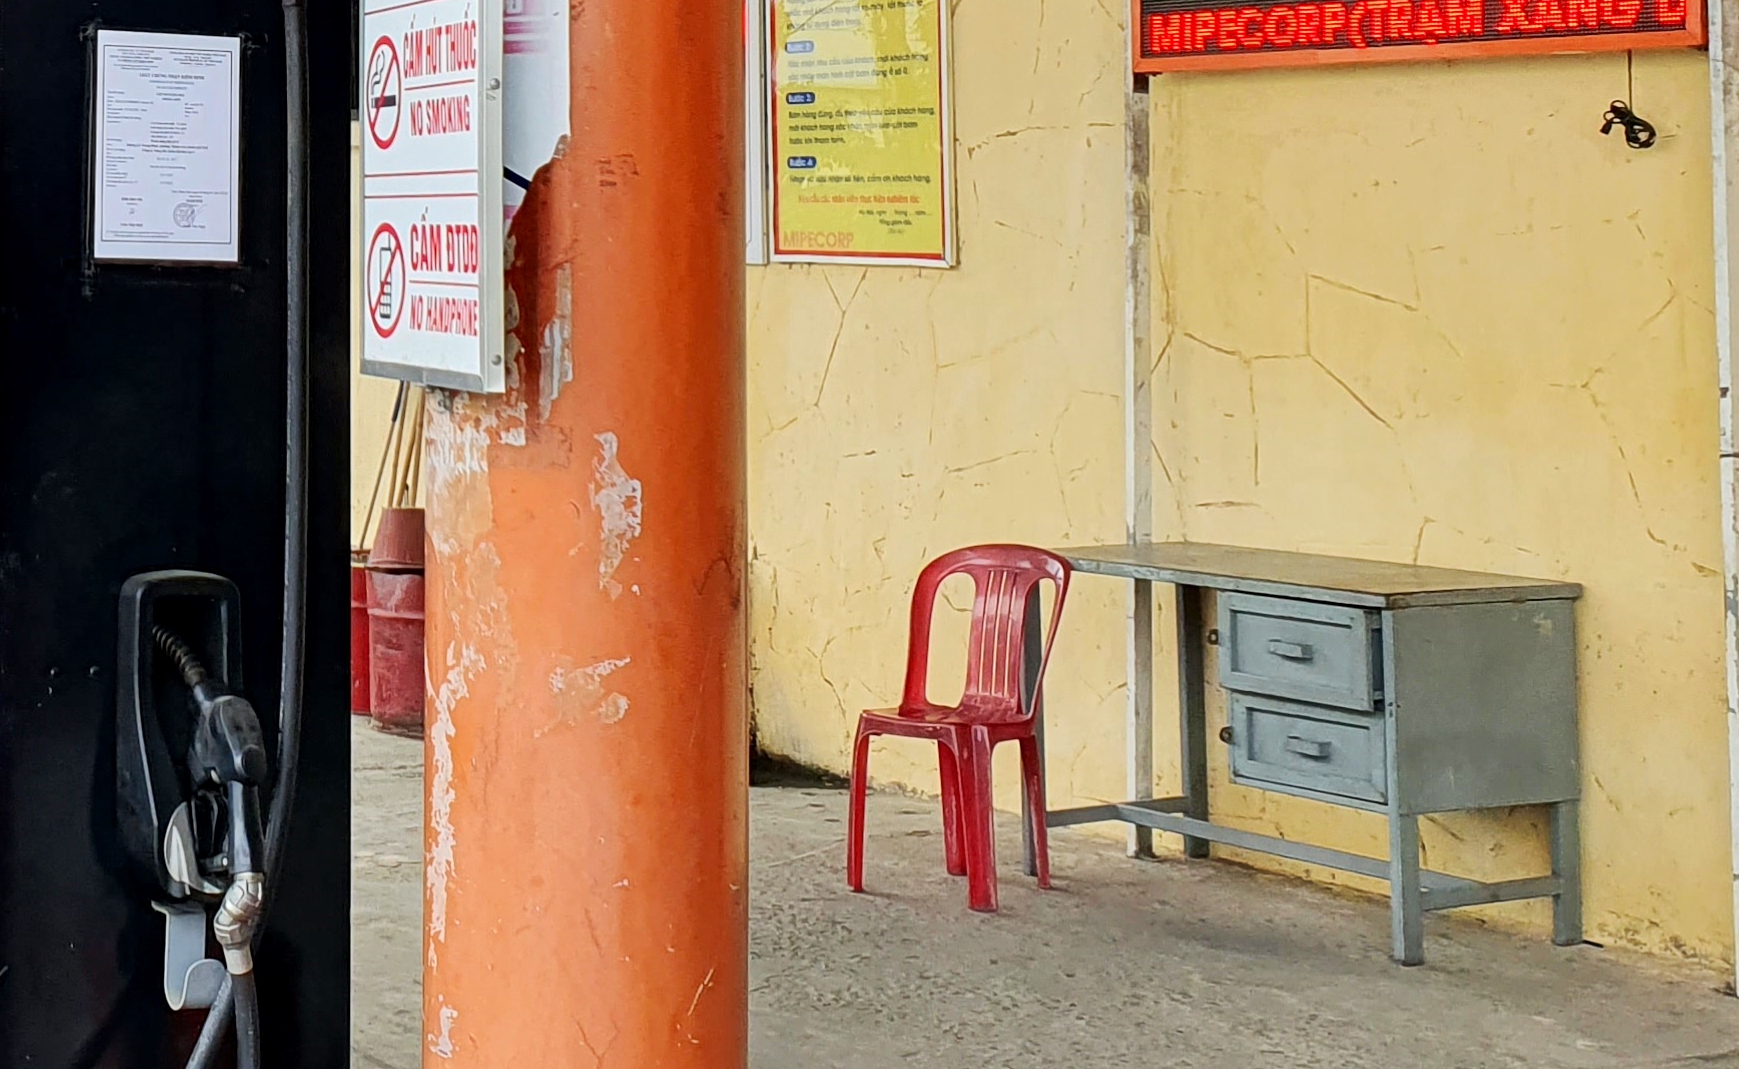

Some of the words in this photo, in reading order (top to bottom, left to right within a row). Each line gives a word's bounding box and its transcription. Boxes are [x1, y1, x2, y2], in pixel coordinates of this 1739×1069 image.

[403, 13, 423, 79] CẤM
[425, 16, 442, 75] HÚT
[445, 2, 477, 73] THUỐC
[410, 100, 424, 137] NO
[426, 94, 471, 136] SMOKING
[410, 205, 442, 272] CẤM
[783, 231, 855, 249] MIPECORP
[409, 294, 423, 331] NO
[425, 295, 478, 337] HANDPHONE
